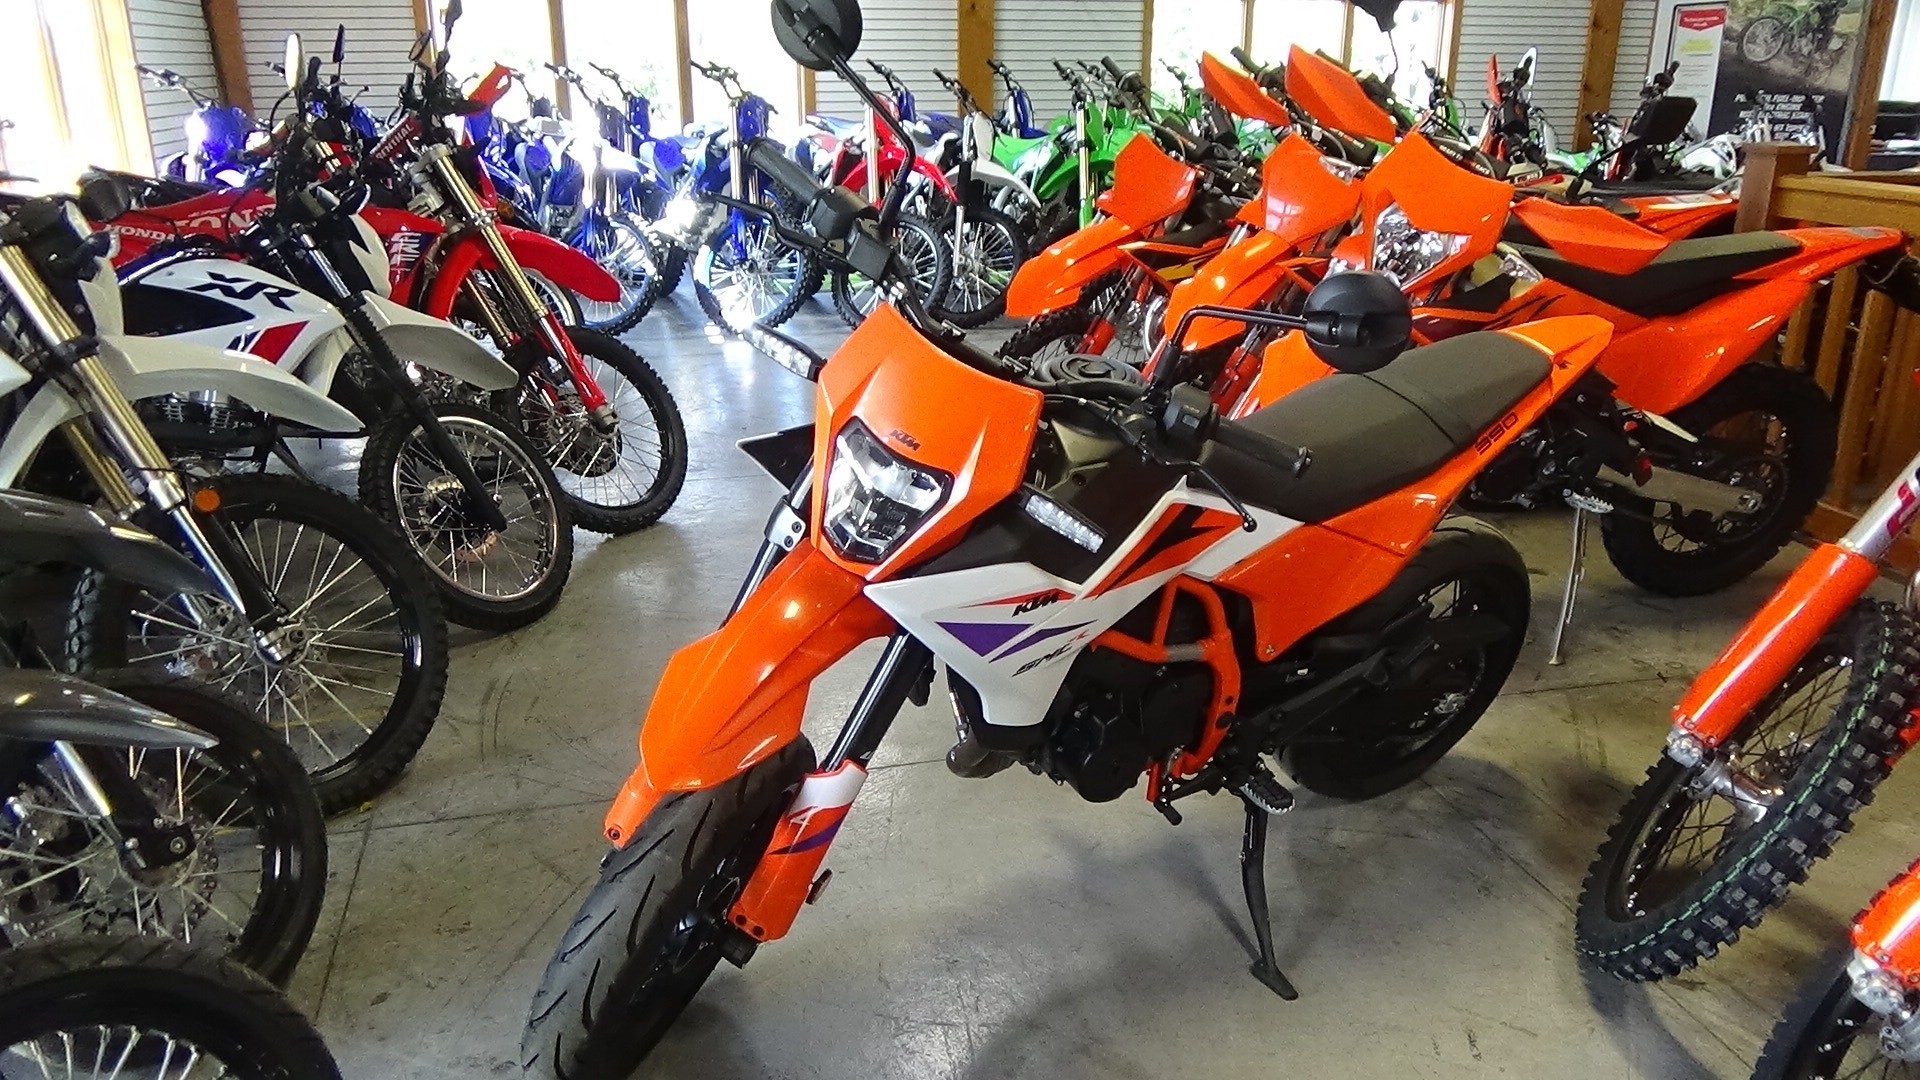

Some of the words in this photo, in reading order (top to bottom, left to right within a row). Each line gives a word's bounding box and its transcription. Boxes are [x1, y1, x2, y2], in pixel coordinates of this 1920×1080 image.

[375, 124, 414, 159] RENTHAL
[185, 271, 301, 313] XR
[890, 429, 921, 451] KTM
[1011, 591, 1060, 617] KTM
